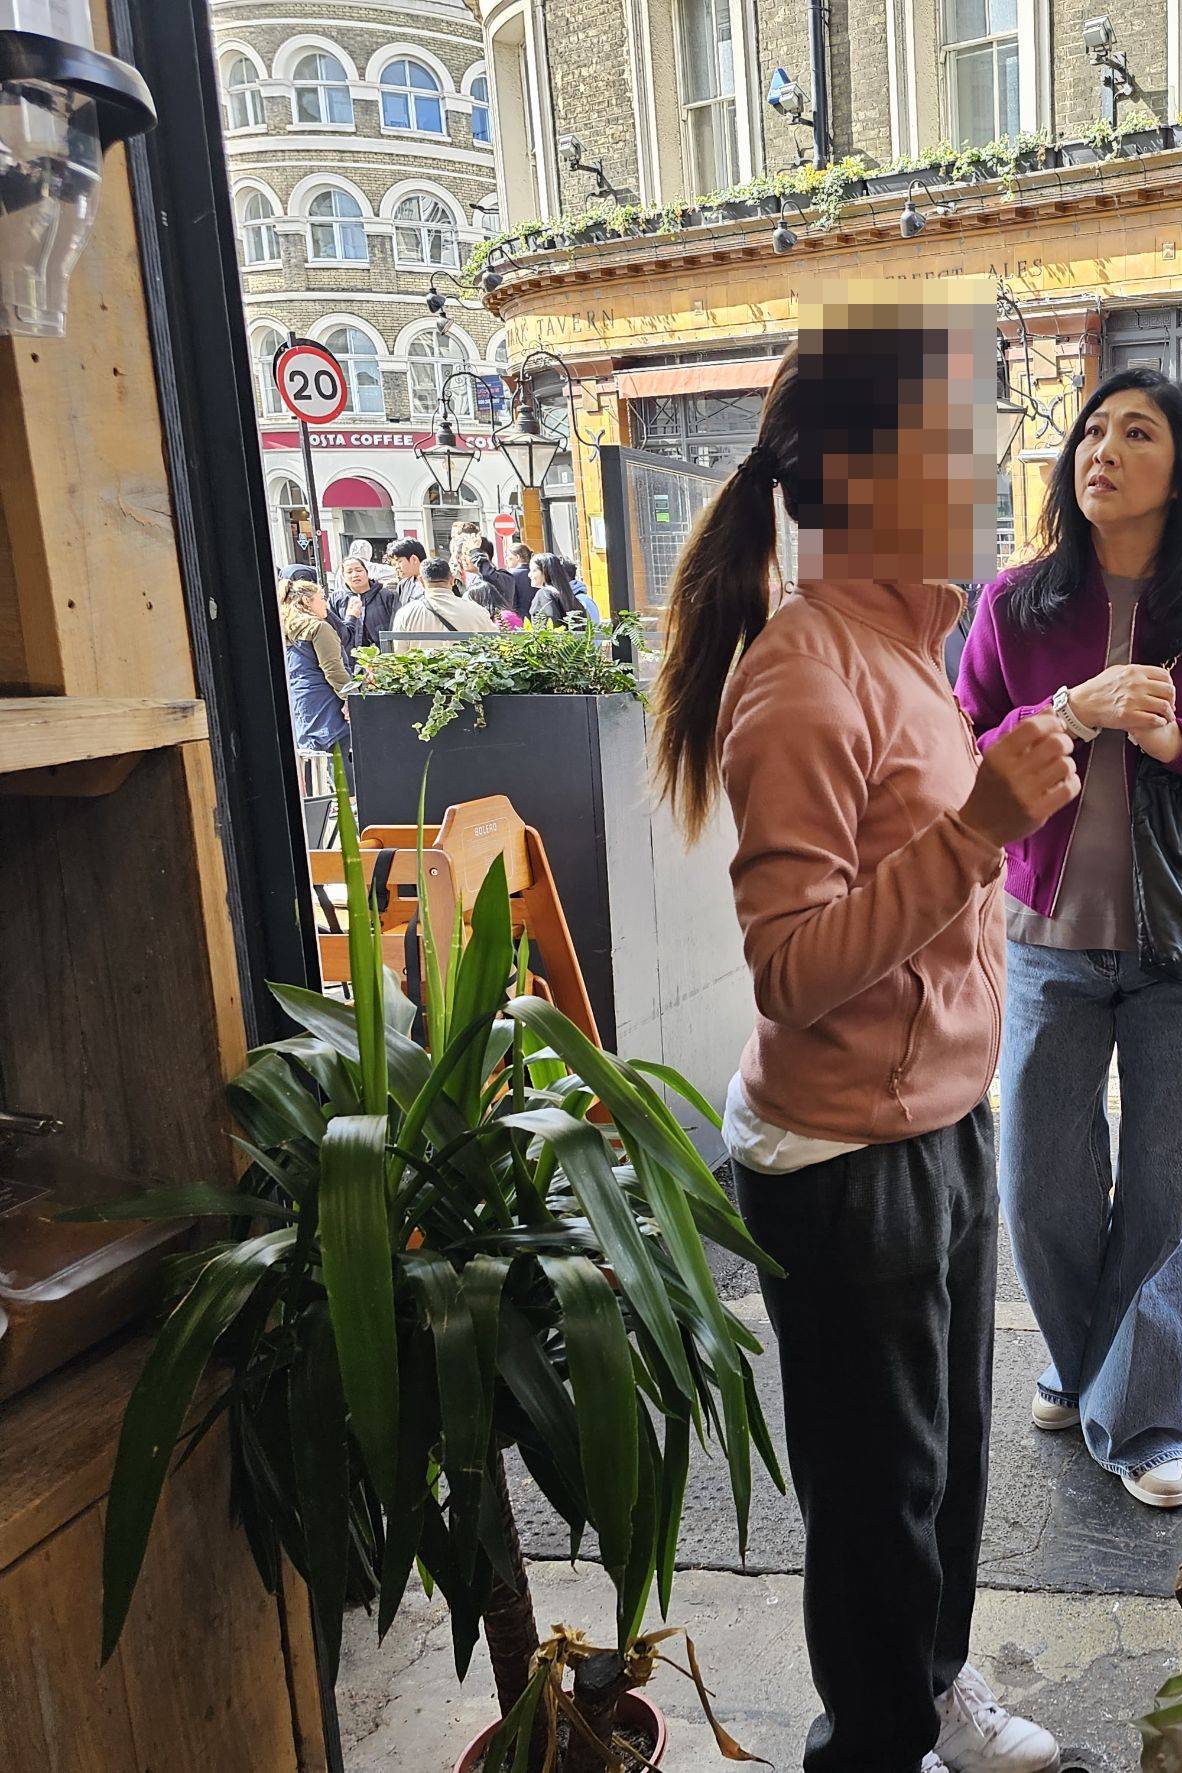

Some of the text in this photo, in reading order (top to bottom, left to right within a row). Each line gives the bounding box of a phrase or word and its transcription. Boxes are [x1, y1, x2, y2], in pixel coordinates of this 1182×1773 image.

[987, 258, 1043, 280] ALES
[536, 308, 616, 338] TAVERN
[289, 369, 338, 401] 20
[309, 433, 414, 448] OSTA COFFEE
[465, 436, 495, 449] COS
[474, 822, 498, 837] BOLERO
